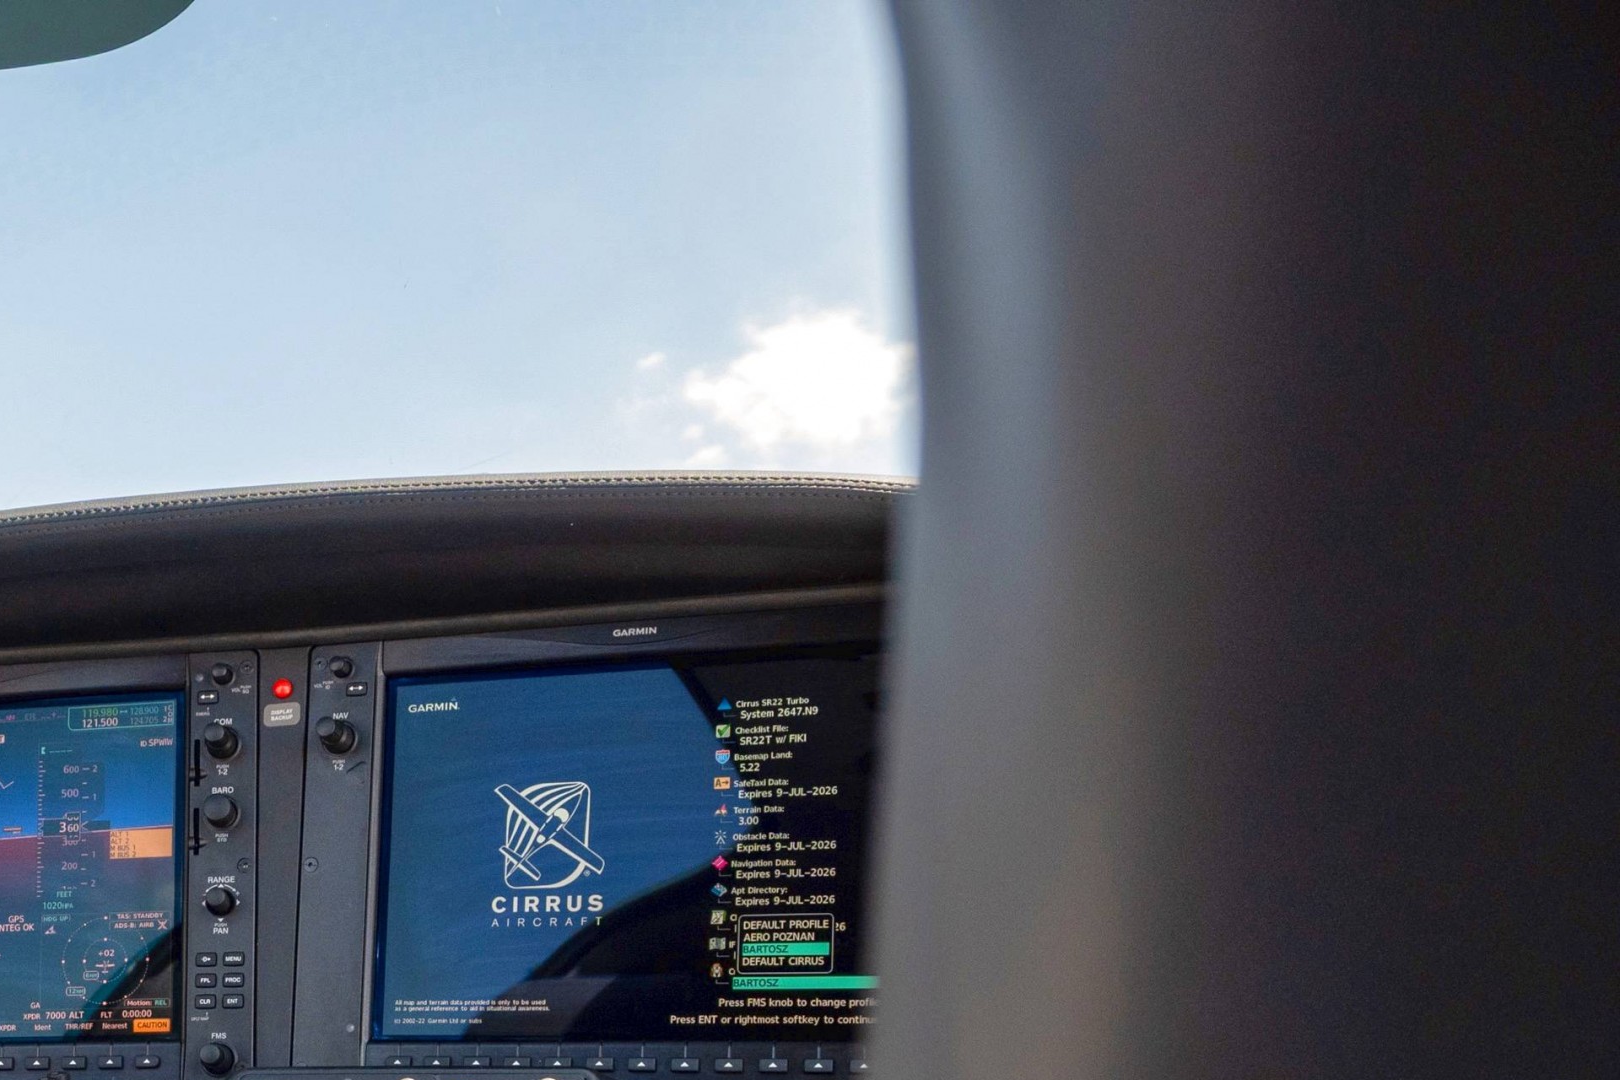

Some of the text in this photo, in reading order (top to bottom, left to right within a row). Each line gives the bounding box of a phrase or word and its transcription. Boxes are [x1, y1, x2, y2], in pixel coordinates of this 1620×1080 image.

[612, 626, 657, 637] GARMIN
[408, 701, 458, 713] GARMIN
[735, 697, 810, 708] Cirrus SR22 Turbo
[82, 708, 118, 718] 119.980
[332, 712, 349, 720] NAV
[740, 706, 819, 720] System 2647.N9
[82, 718, 118, 728] 121.500
[735, 724, 789, 734] Checklist File:
[740, 734, 807, 746] SR22T FIKI
[734, 751, 793, 761] Basemap Land:
[63, 765, 79, 774] 600
[740, 762, 760, 772] 5.22
[733, 778, 789, 787] SafeTaxi Data:
[61, 789, 79, 798] 500
[211, 786, 234, 794] BARO
[738, 786, 838, 800] Expires 9-JUL-2026
[733, 805, 785, 814] Terrain Data:
[738, 816, 759, 825] 3.00
[732, 832, 790, 841] Obstacle Data:
[736, 840, 837, 854] Expires 9-JUL-2026
[731, 858, 797, 869] Navigation Data:
[735, 868, 836, 880] Expires 9-JUL-2026
[731, 886, 788, 895] Apt Directory:
[491, 894, 604, 914] CIRRUS
[735, 895, 836, 907] Expires 9-JUL-2026
[8, 915, 25, 924] GPS
[491, 916, 602, 927] AIRCRAFT
[743, 919, 829, 930] DEFAULT PROFILE
[23, 923, 35, 931] OK
[743, 932, 815, 942] AERO POZNAN
[743, 945, 788, 954] BARTOSZ
[742, 956, 825, 966] DEFAULT CIRRUS
[733, 978, 779, 988] BARTOSZ
[718, 998, 847, 1010] Press FMS knob to change
[45, 1010, 152, 1020] 7000 0:00:00
[670, 1014, 834, 1026] Press ENT or rightmost softkey to
[137, 1021, 167, 1029] CAUTION
